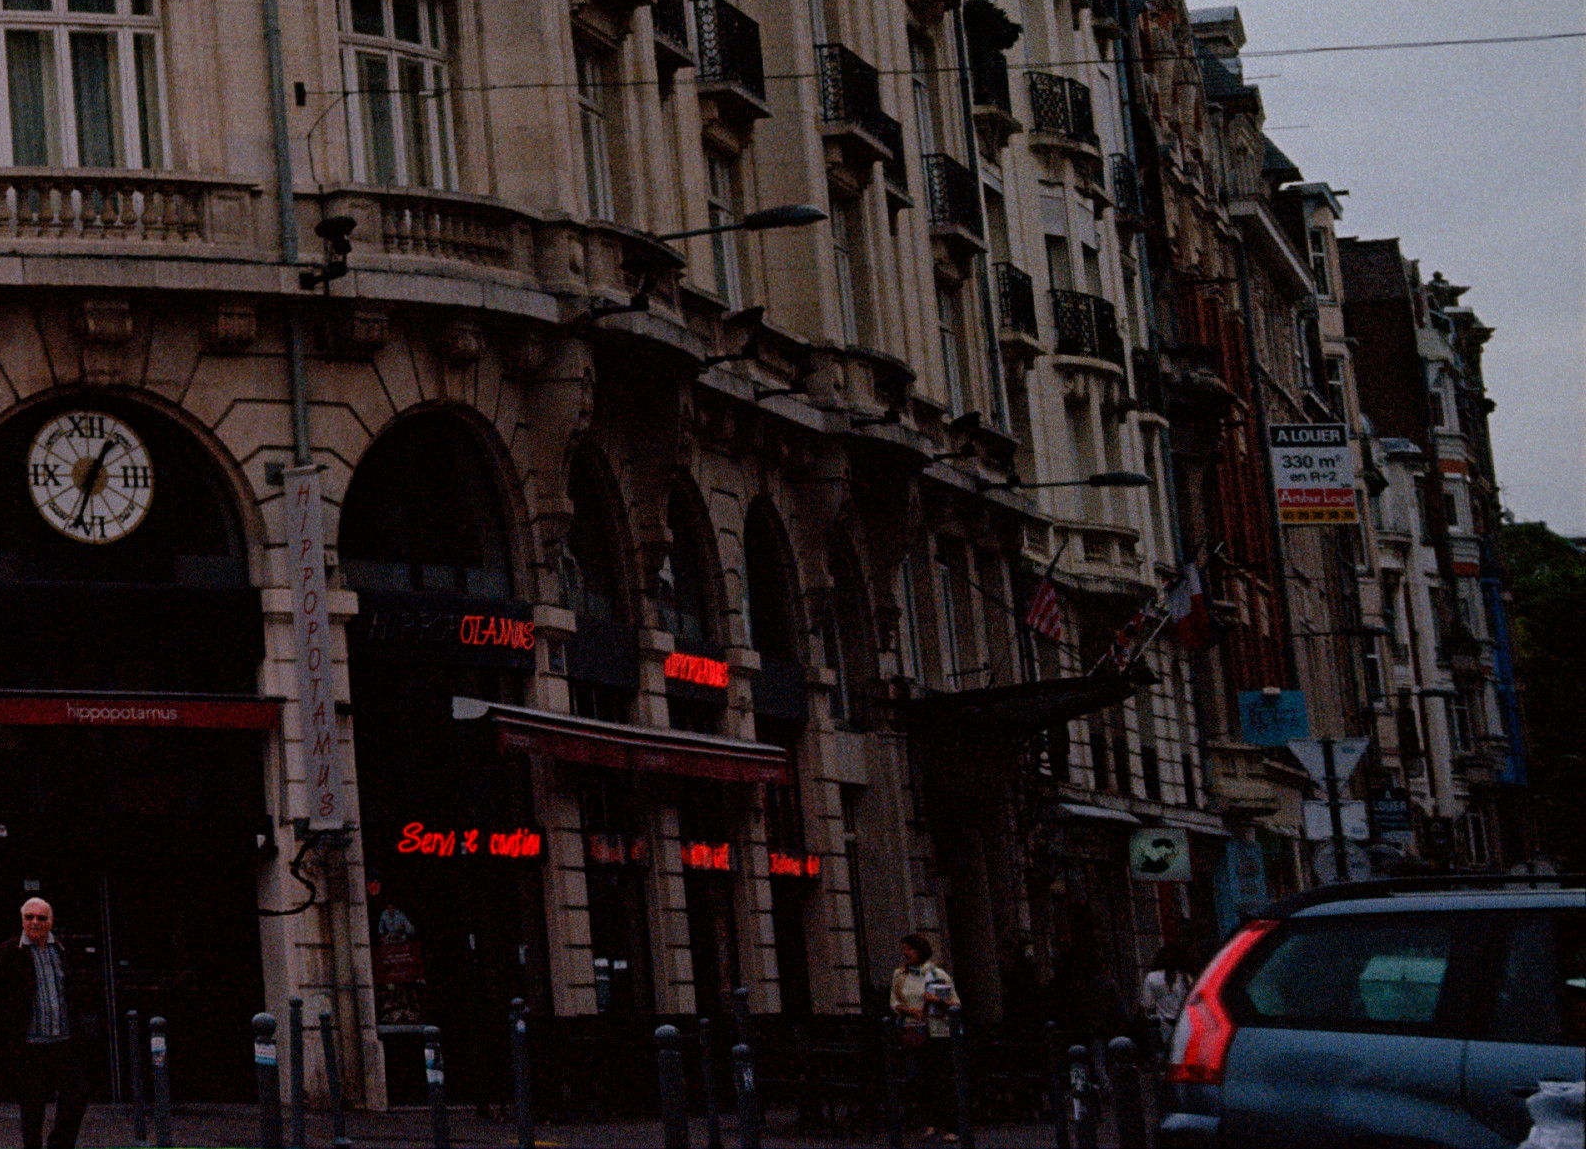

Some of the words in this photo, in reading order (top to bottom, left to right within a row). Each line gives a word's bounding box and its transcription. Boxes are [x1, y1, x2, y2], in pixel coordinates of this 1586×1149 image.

[68, 416, 105, 438] XII
[1277, 430, 1288, 442] A
[1291, 429, 1341, 442] LOUER
[1282, 455, 1313, 468] 330
[31, 464, 62, 486] IX
[121, 466, 150, 488] III
[296, 483, 335, 818] HIPPOPOTAMUS
[66, 702, 178, 722] hippopotamus
